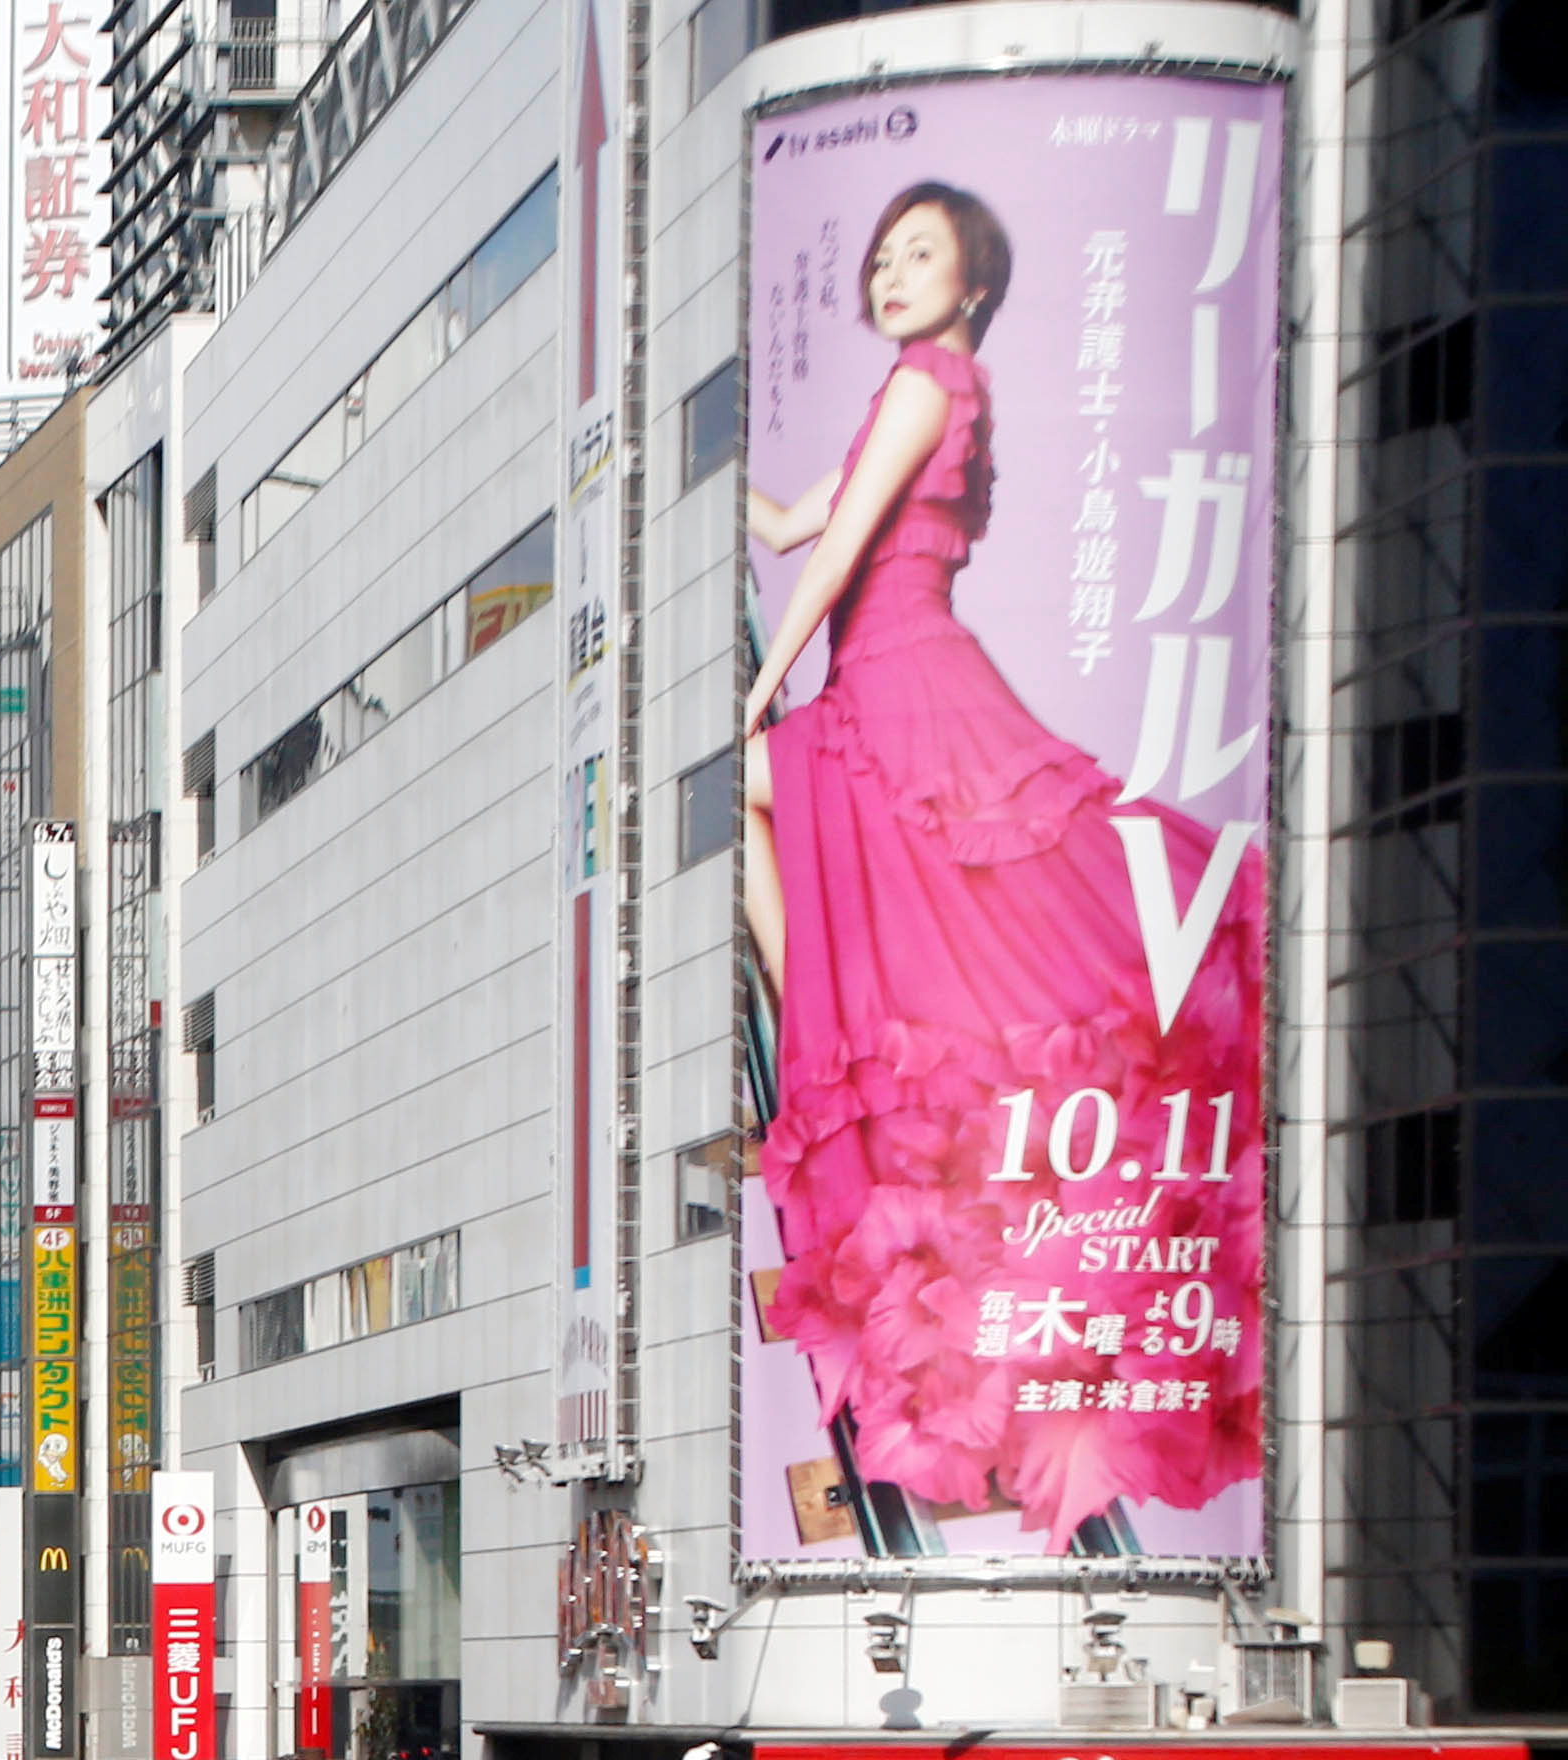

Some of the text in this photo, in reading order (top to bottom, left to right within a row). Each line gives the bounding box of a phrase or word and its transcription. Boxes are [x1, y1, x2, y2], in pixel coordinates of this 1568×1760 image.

[20, 2, 93, 304] 大和証券
[986, 1086, 1236, 1183] 10.11
[1002, 1185, 1164, 1258] Special
[1078, 1235, 1220, 1274] START
[37, 1250, 71, 1431] 八重洲コンタクト
[161, 1540, 207, 1555] MUFG
[44, 1636, 64, 1751] McDonald's
